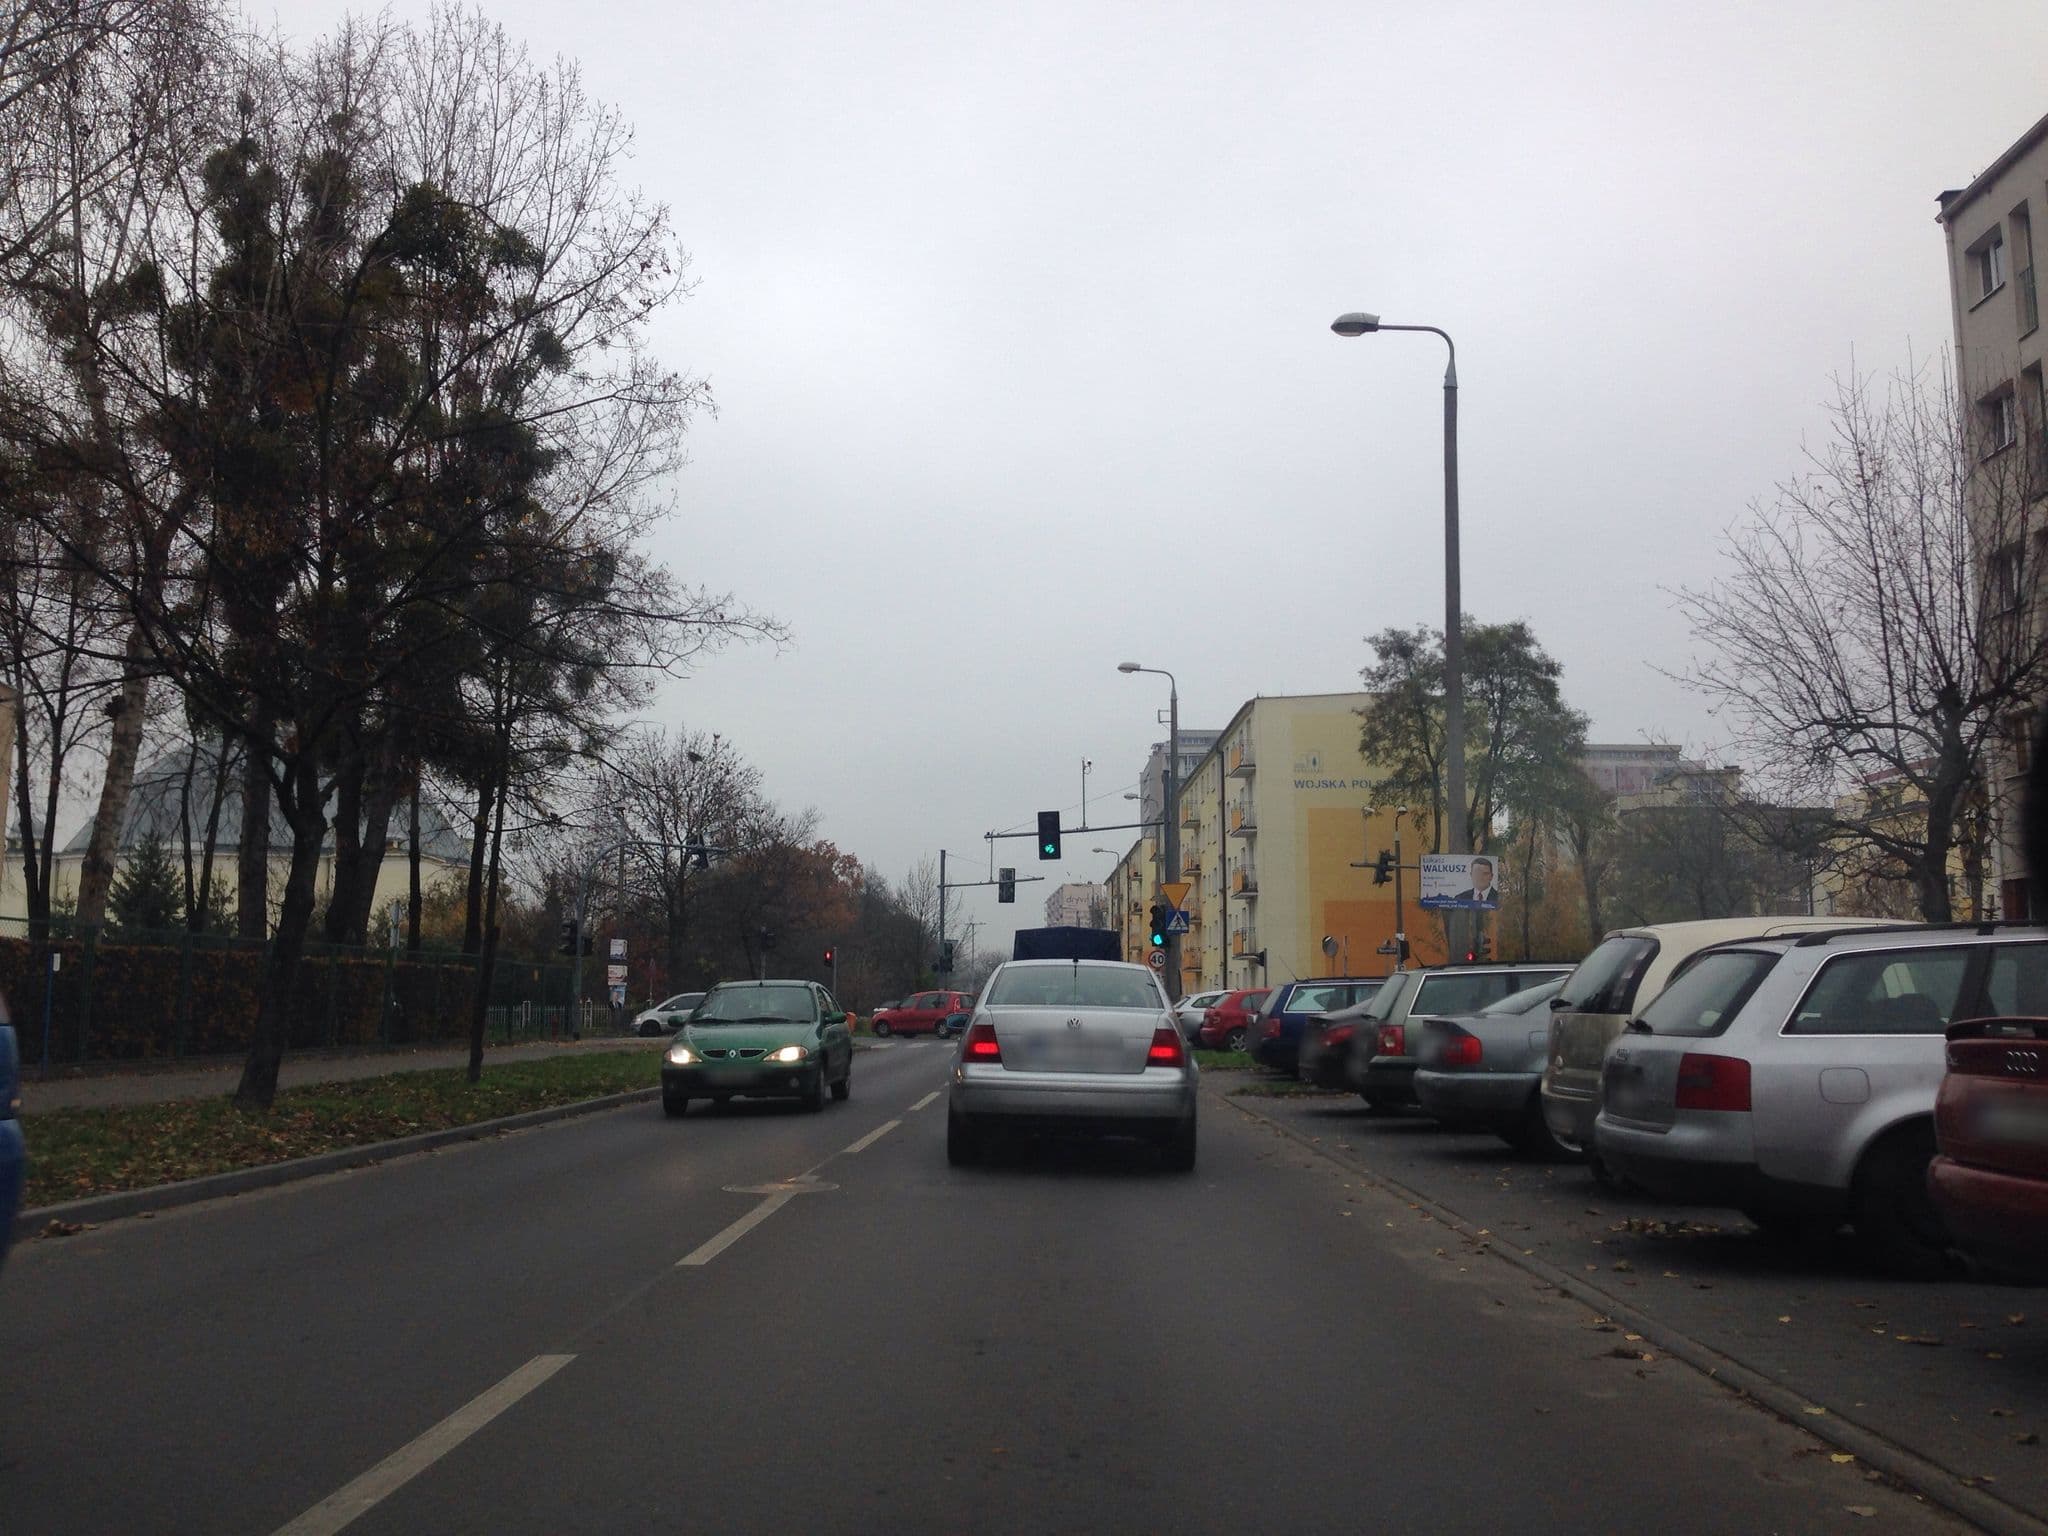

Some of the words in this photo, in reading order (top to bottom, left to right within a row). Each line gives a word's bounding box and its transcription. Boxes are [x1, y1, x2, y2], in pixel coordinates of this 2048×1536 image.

[1294, 779, 1347, 789] WOJSKA
[1423, 864, 1467, 873] WALKUSZ
[1151, 954, 1164, 964] 40
